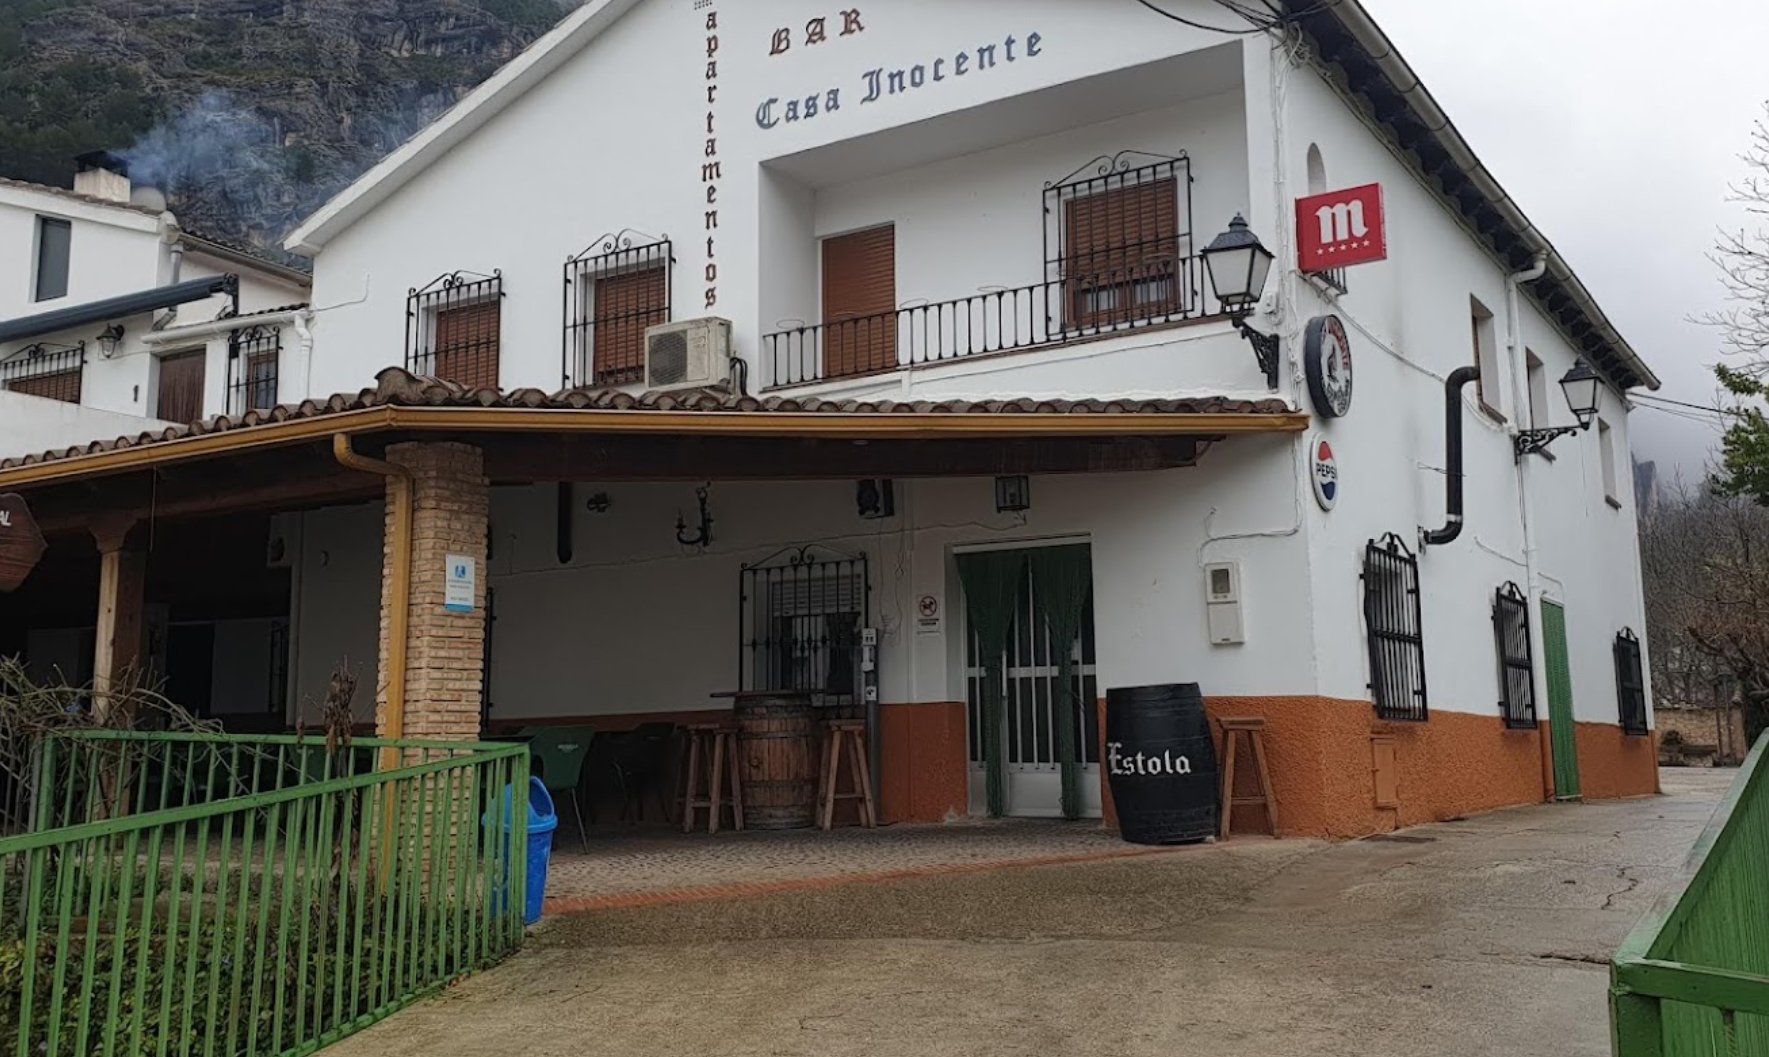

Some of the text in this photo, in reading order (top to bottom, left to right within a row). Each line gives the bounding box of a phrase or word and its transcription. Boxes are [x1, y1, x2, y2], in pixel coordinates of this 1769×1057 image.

[769, 8, 864, 56] BAR
[756, 31, 1042, 129] Casa Inocente
[701, 11, 721, 310] apartamentos
[1107, 742, 1192, 775] Estola
